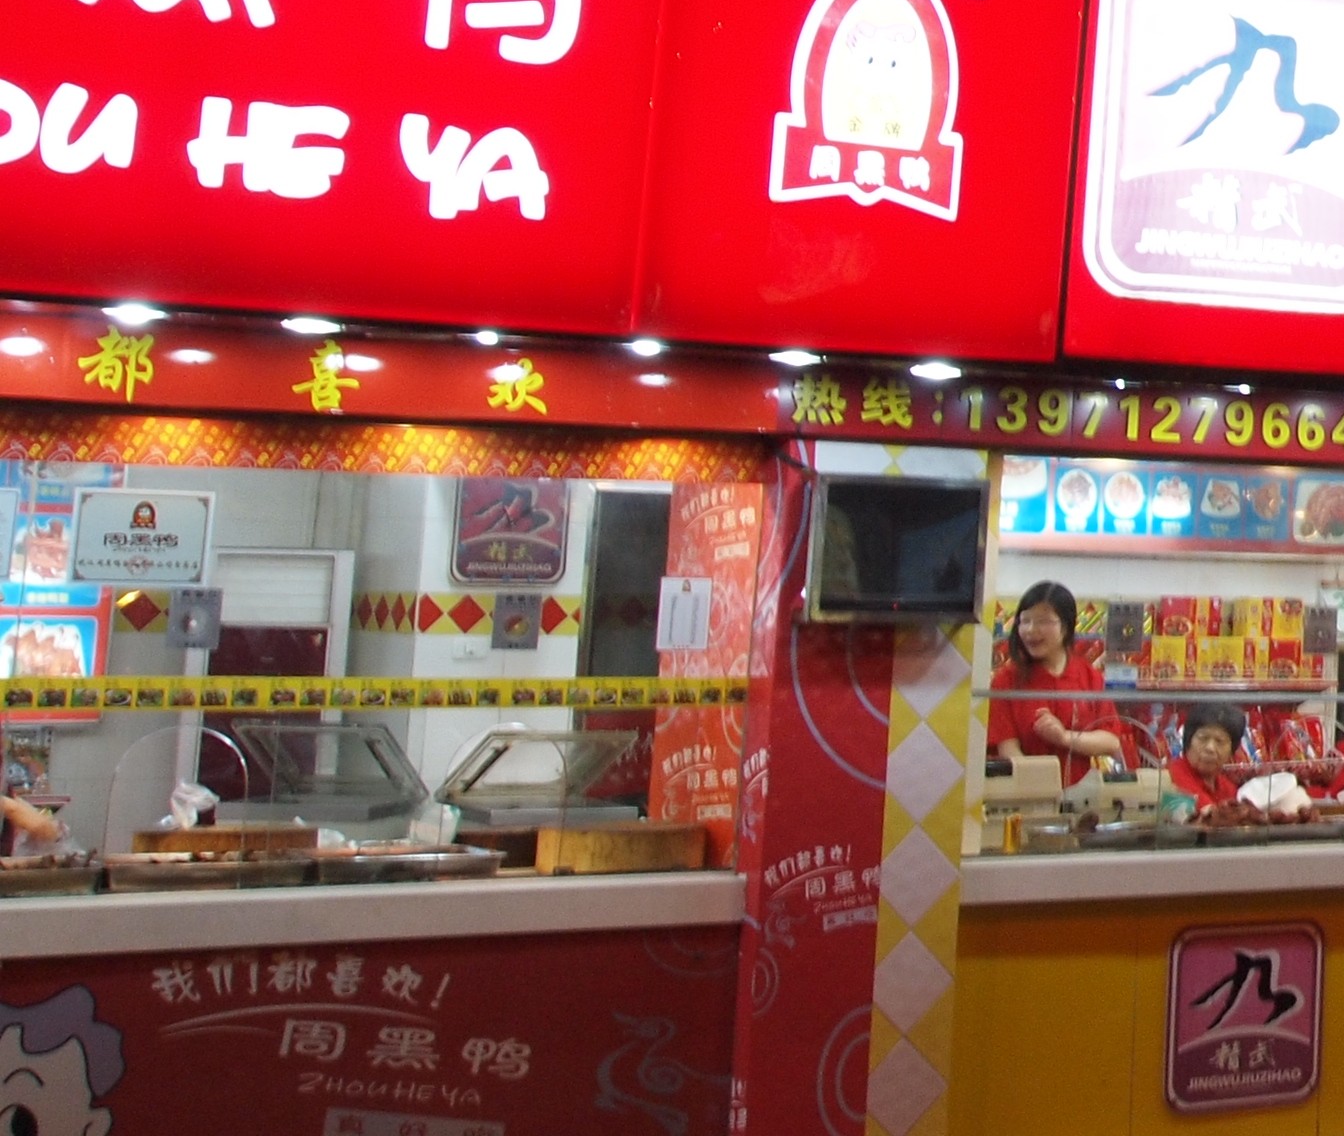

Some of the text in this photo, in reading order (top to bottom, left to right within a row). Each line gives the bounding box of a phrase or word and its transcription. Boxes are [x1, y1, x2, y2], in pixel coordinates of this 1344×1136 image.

[187, 95, 351, 200] HE
[398, 111, 550, 221] YA
[78, 324, 548, 417] 都喜欢
[151, 956, 450, 1008] 我们都喜欢!
[279, 1019, 532, 1081] 周黑鸭
